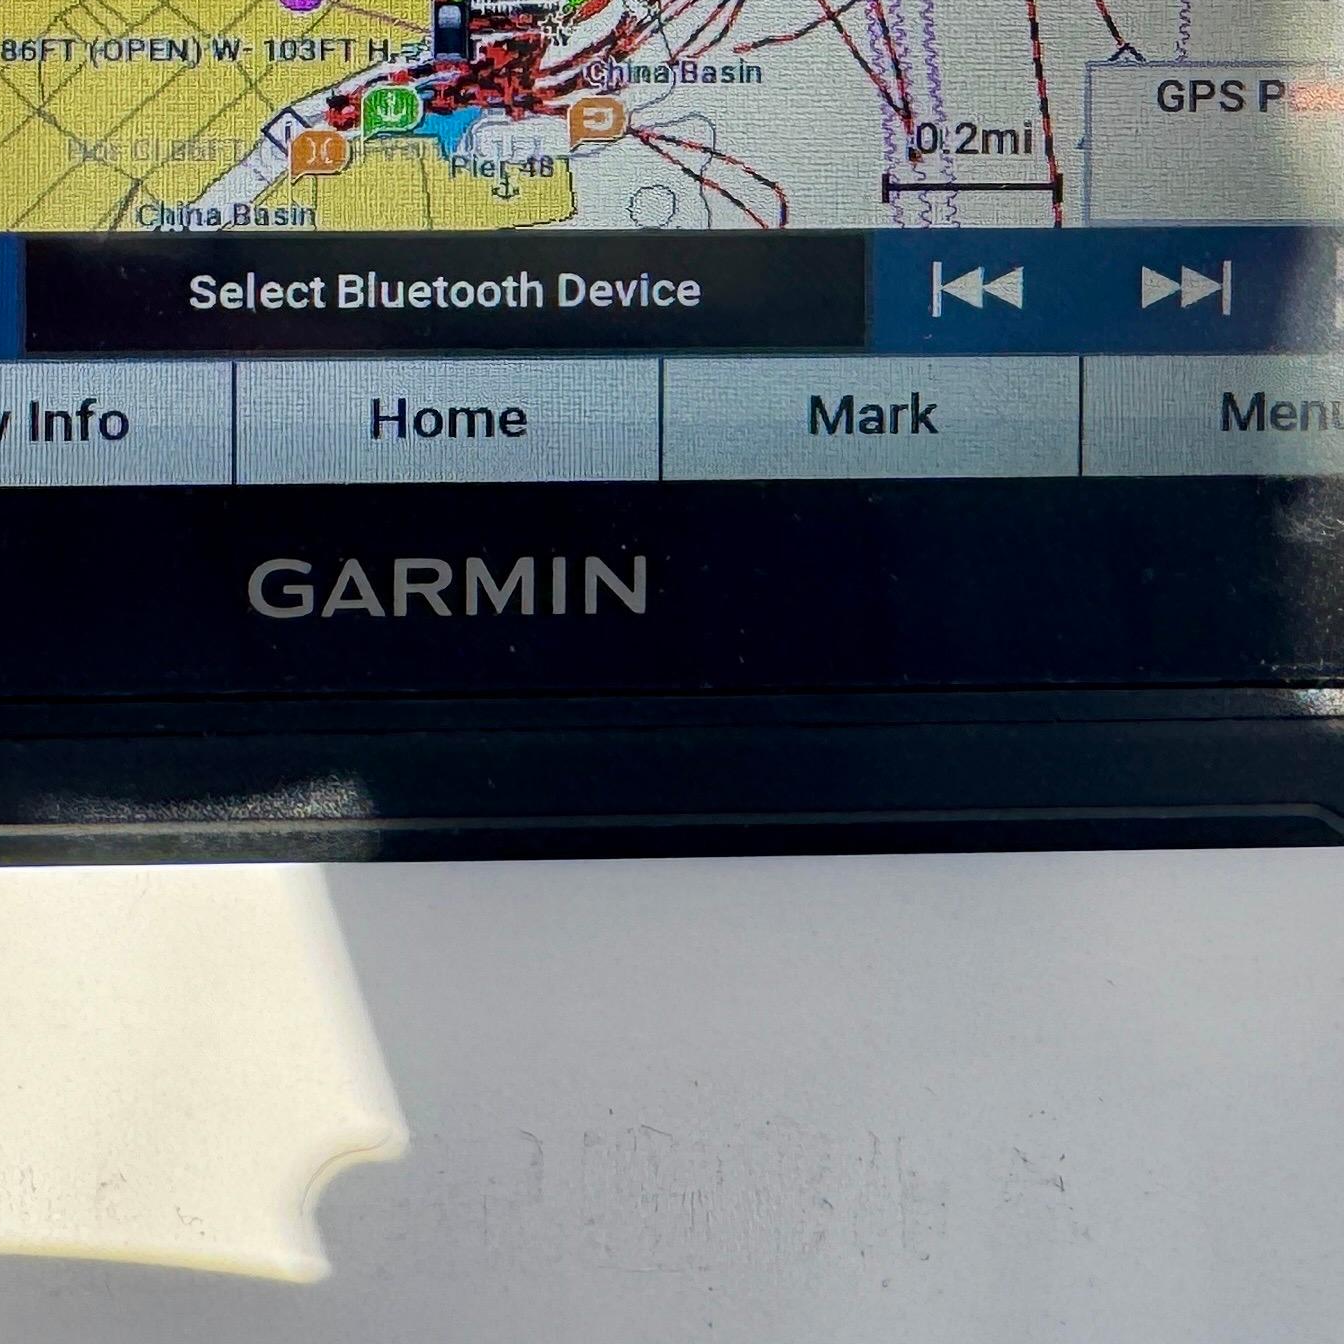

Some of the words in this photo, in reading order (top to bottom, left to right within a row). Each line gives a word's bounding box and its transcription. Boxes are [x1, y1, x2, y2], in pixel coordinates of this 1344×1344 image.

[0, 38, 85, 63] 86FT
[89, 36, 203, 68] (OPEN)
[263, 38, 356, 63] 103FT
[586, 58, 672, 85] China
[679, 57, 763, 84] Basin
[1156, 80, 1247, 114] GPS
[914, 119, 1034, 157] 0.2mi
[451, 156, 508, 179] Pier
[137, 203, 223, 228] China
[232, 202, 316, 228] Basin
[188, 272, 327, 312] Select
[337, 271, 544, 311] Bluetooth
[557, 271, 702, 309] Device
[29, 398, 132, 443] Info
[370, 398, 529, 441] Home
[808, 393, 939, 437] Mark
[247, 554, 648, 619] GARMIN
